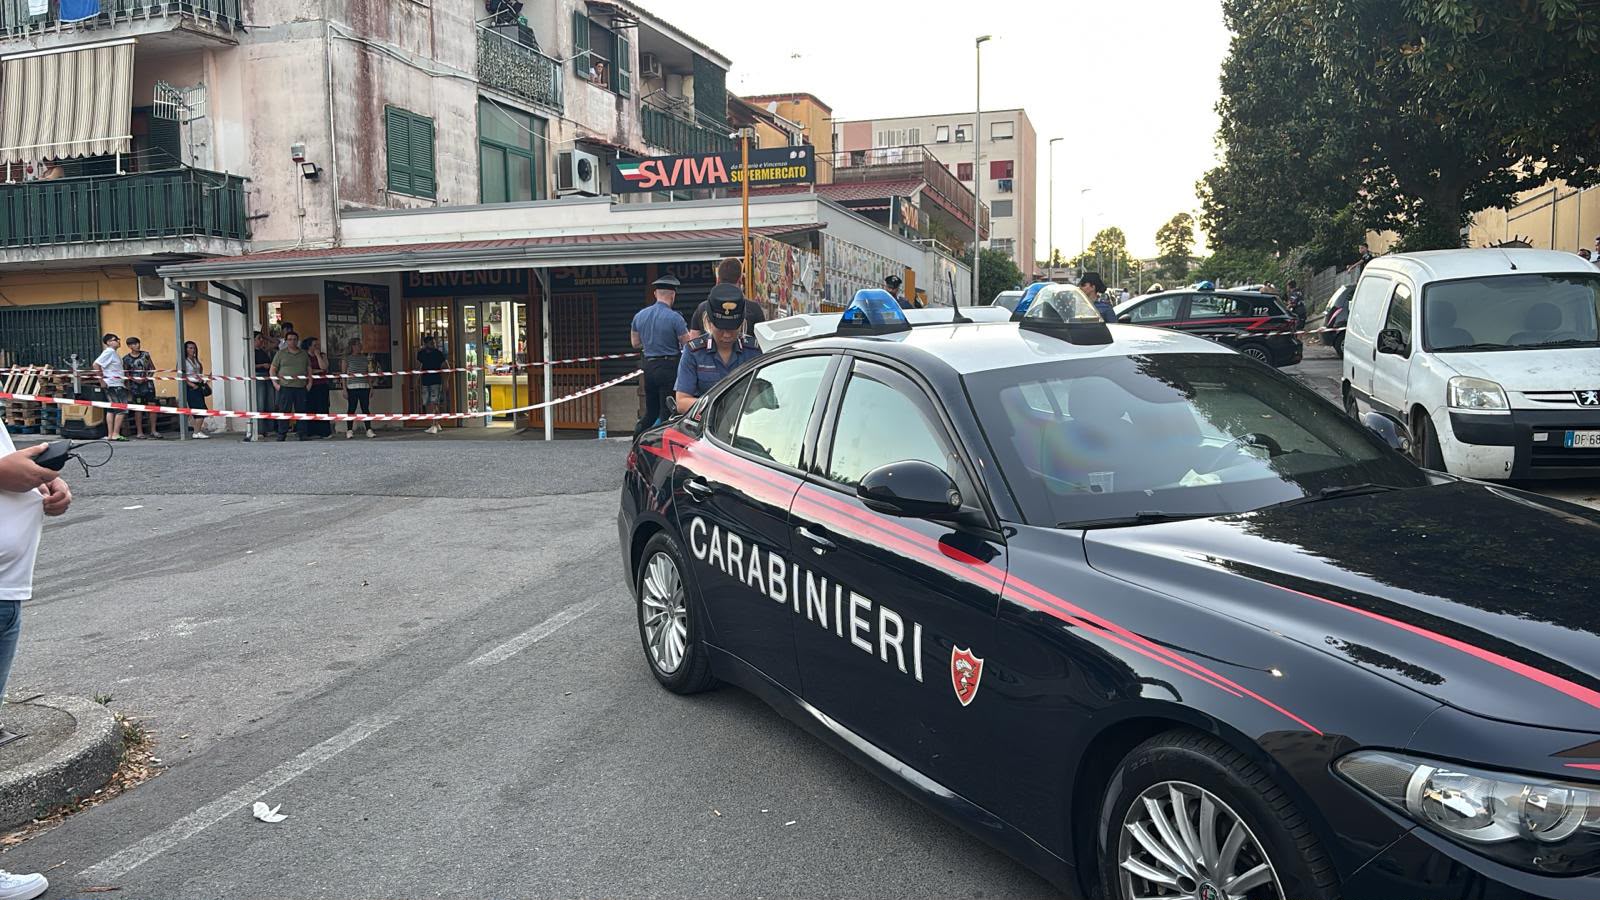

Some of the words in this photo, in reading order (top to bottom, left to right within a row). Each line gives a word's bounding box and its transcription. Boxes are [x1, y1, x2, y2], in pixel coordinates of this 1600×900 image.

[731, 166, 806, 182] SUERMERCATO
[1253, 306, 1269, 315] 112
[689, 516, 924, 684] CARABINIERI
